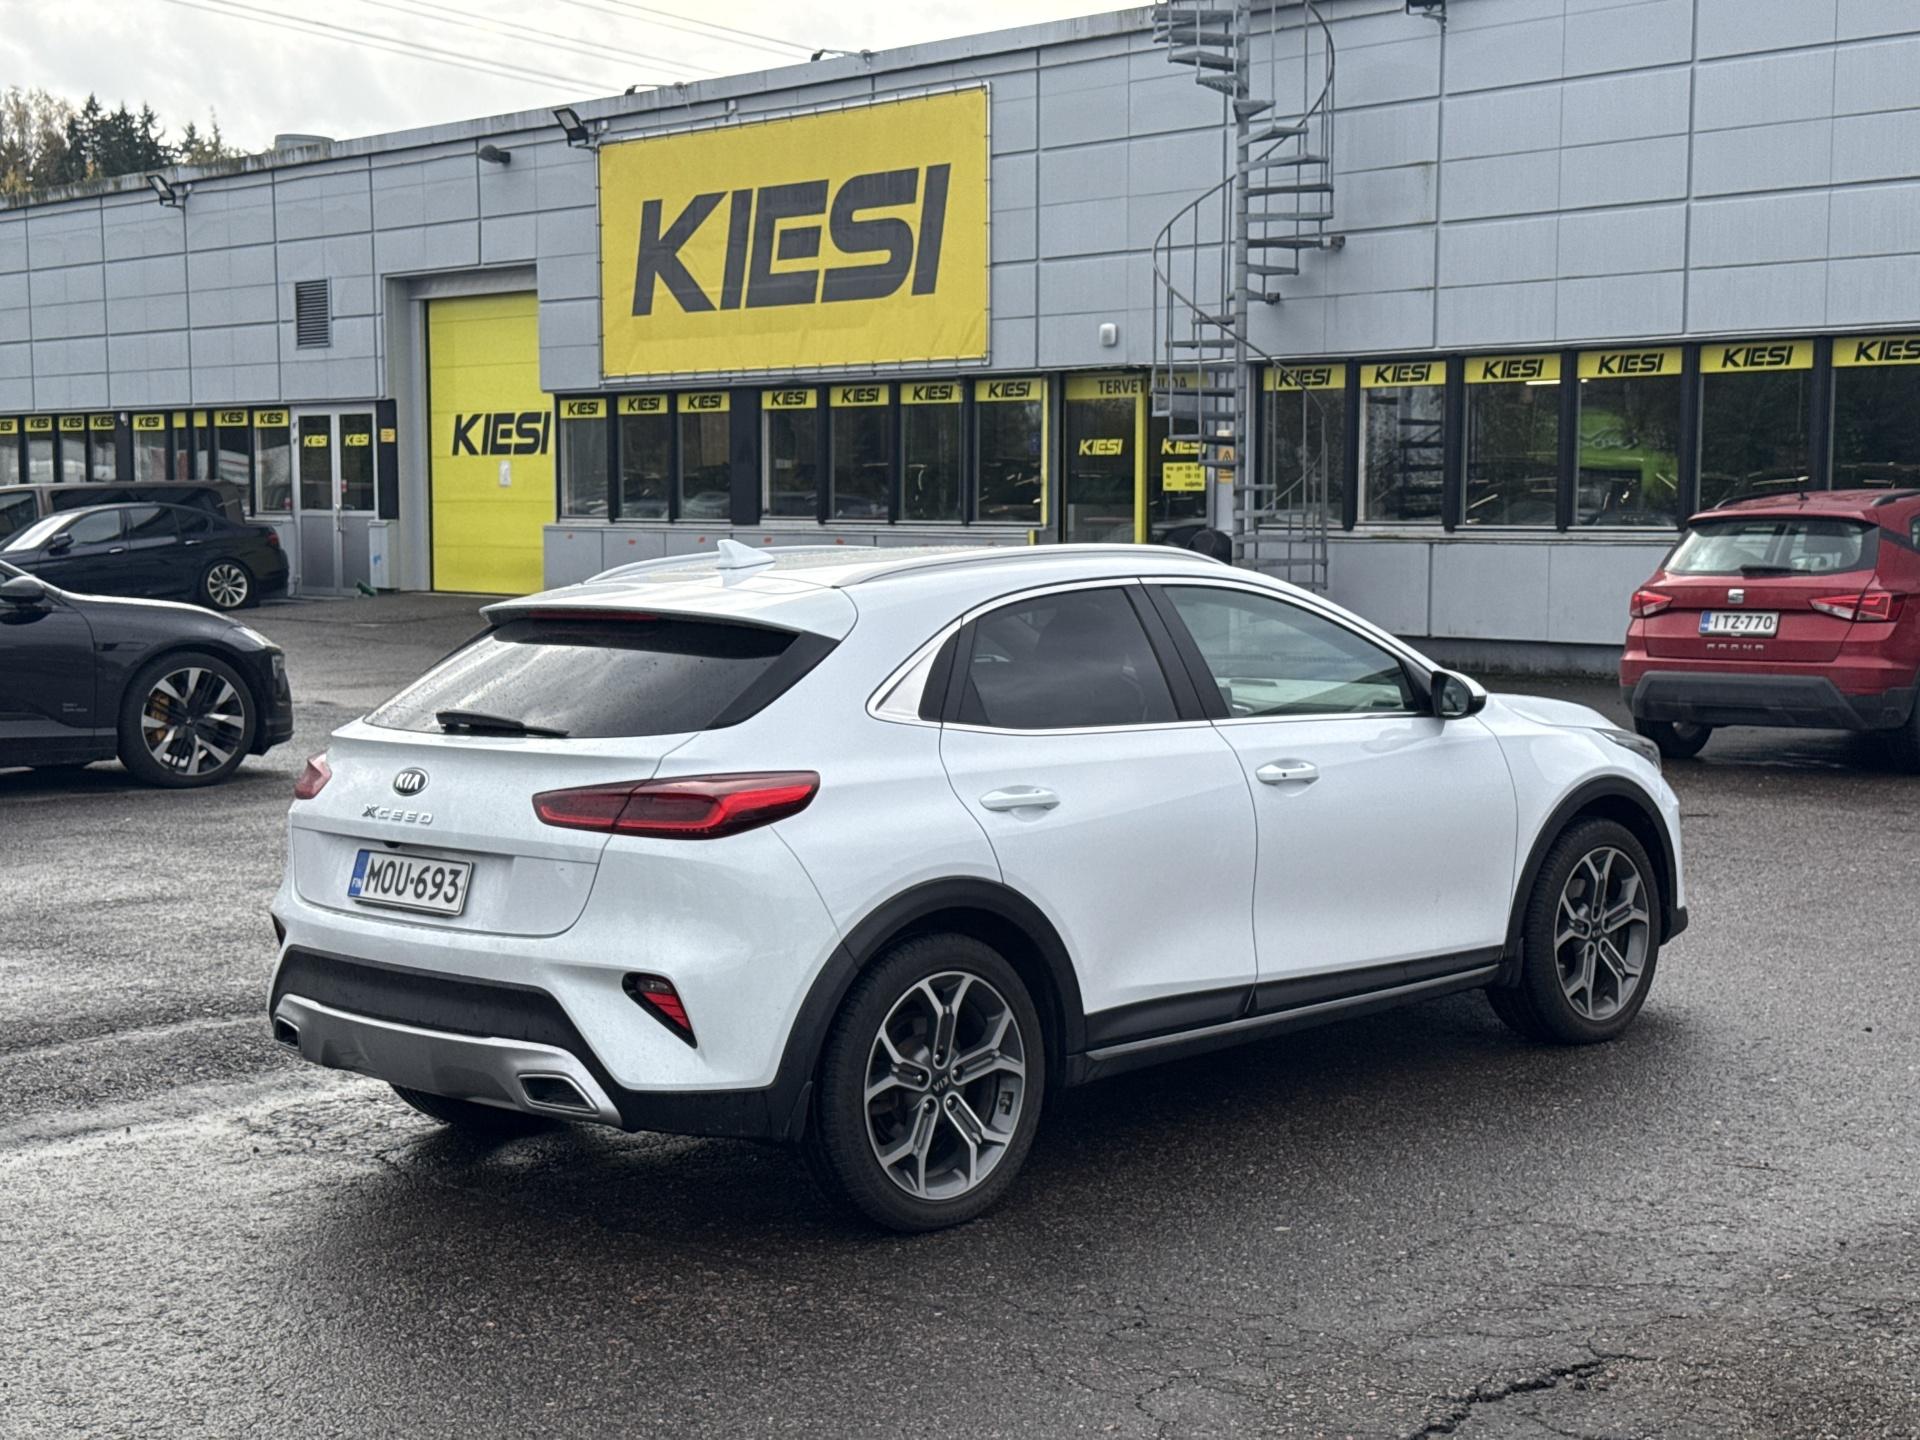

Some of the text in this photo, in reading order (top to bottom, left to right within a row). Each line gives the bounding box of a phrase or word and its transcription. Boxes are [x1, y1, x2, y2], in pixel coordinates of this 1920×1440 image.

[632, 163, 951, 316] KIESI
[1721, 345, 1794, 369] KIESI
[1854, 339, 1920, 363] KIES
[1374, 363, 1432, 384] KIESI
[1482, 359, 1544, 380] KIESI
[1597, 353, 1664, 375] KIESI
[1278, 367, 1332, 388] KIESI
[771, 391, 807, 406] KIESI
[841, 387, 880, 403] KIESI
[912, 384, 953, 401] KIESI
[988, 381, 1031, 398] KIESI
[567, 401, 599, 416] KIESI
[627, 397, 660, 412] KIESI
[687, 394, 722, 410] KIESI
[452, 411, 552, 456] KIESI
[1078, 438, 1124, 456] KIESI
[1713, 615, 1774, 630] ITZ-770
[396, 772, 421, 790] KIA
[362, 803, 434, 825] XCEED
[364, 857, 463, 904] MOU-693
